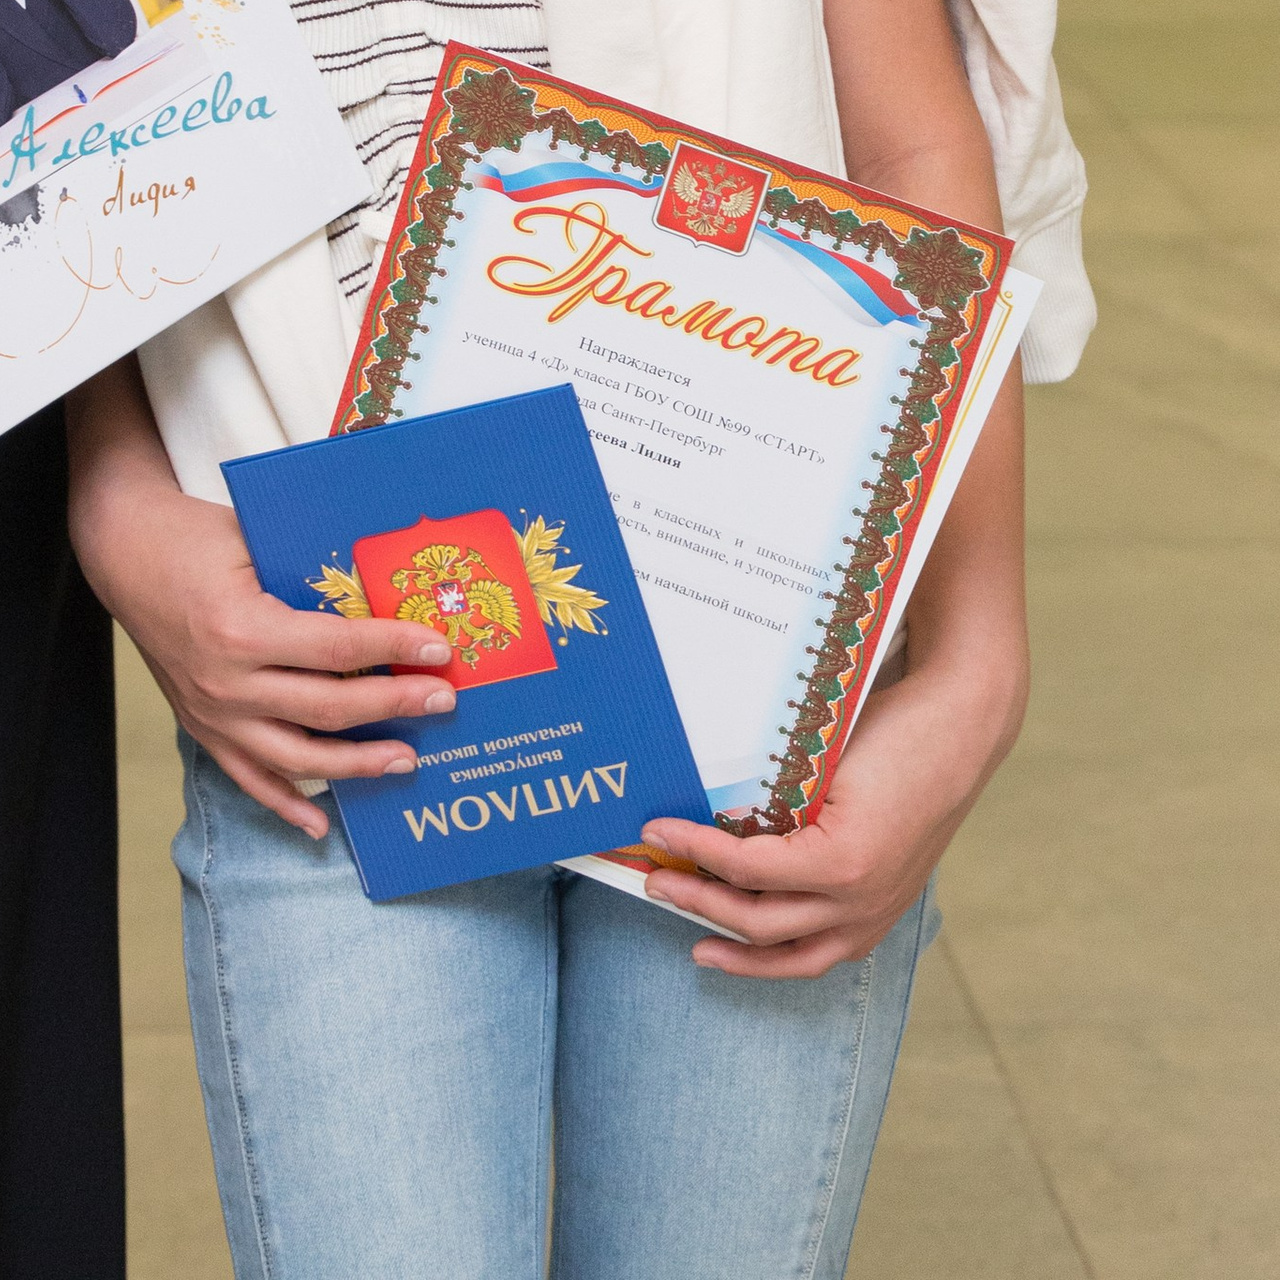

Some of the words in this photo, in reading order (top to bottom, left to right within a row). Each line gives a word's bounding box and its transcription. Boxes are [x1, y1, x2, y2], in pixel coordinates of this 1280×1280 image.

[2, 71, 277, 188] Алексеева
[102, 166, 197, 217] Лидия
[486, 201, 863, 388] Грамота
[579, 336, 692, 388] Награждается
[462, 330, 525, 360] ученица
[527, 349, 537, 363] 4
[540, 355, 570, 374] «Д»
[573, 367, 620, 391] класса
[623, 381, 671, 407] ГБОУ
[672, 399, 714, 425] СОШ
[715, 415, 751, 438] №99
[754, 431, 825, 466] «СТАРТ»
[588, 428, 628, 449] сеева
[631, 442, 681, 470] Лидия
[601, 401, 728, 457] Санкт-Петербург
[632, 500, 642, 510] в
[654, 507, 723, 540] классных
[735, 537, 744, 548] и
[757, 546, 831, 582] школьных
[656, 529, 729, 565] внимание,
[734, 558, 743, 568] и
[745, 562, 813, 596] упорство
[654, 575, 730, 612] начальной
[733, 605, 789, 635] школы!
[417, 744, 479, 769] школы
[449, 749, 563, 784] выпускника
[484, 721, 583, 756] начальной
[403, 761, 628, 842] ДИПЛОМ
